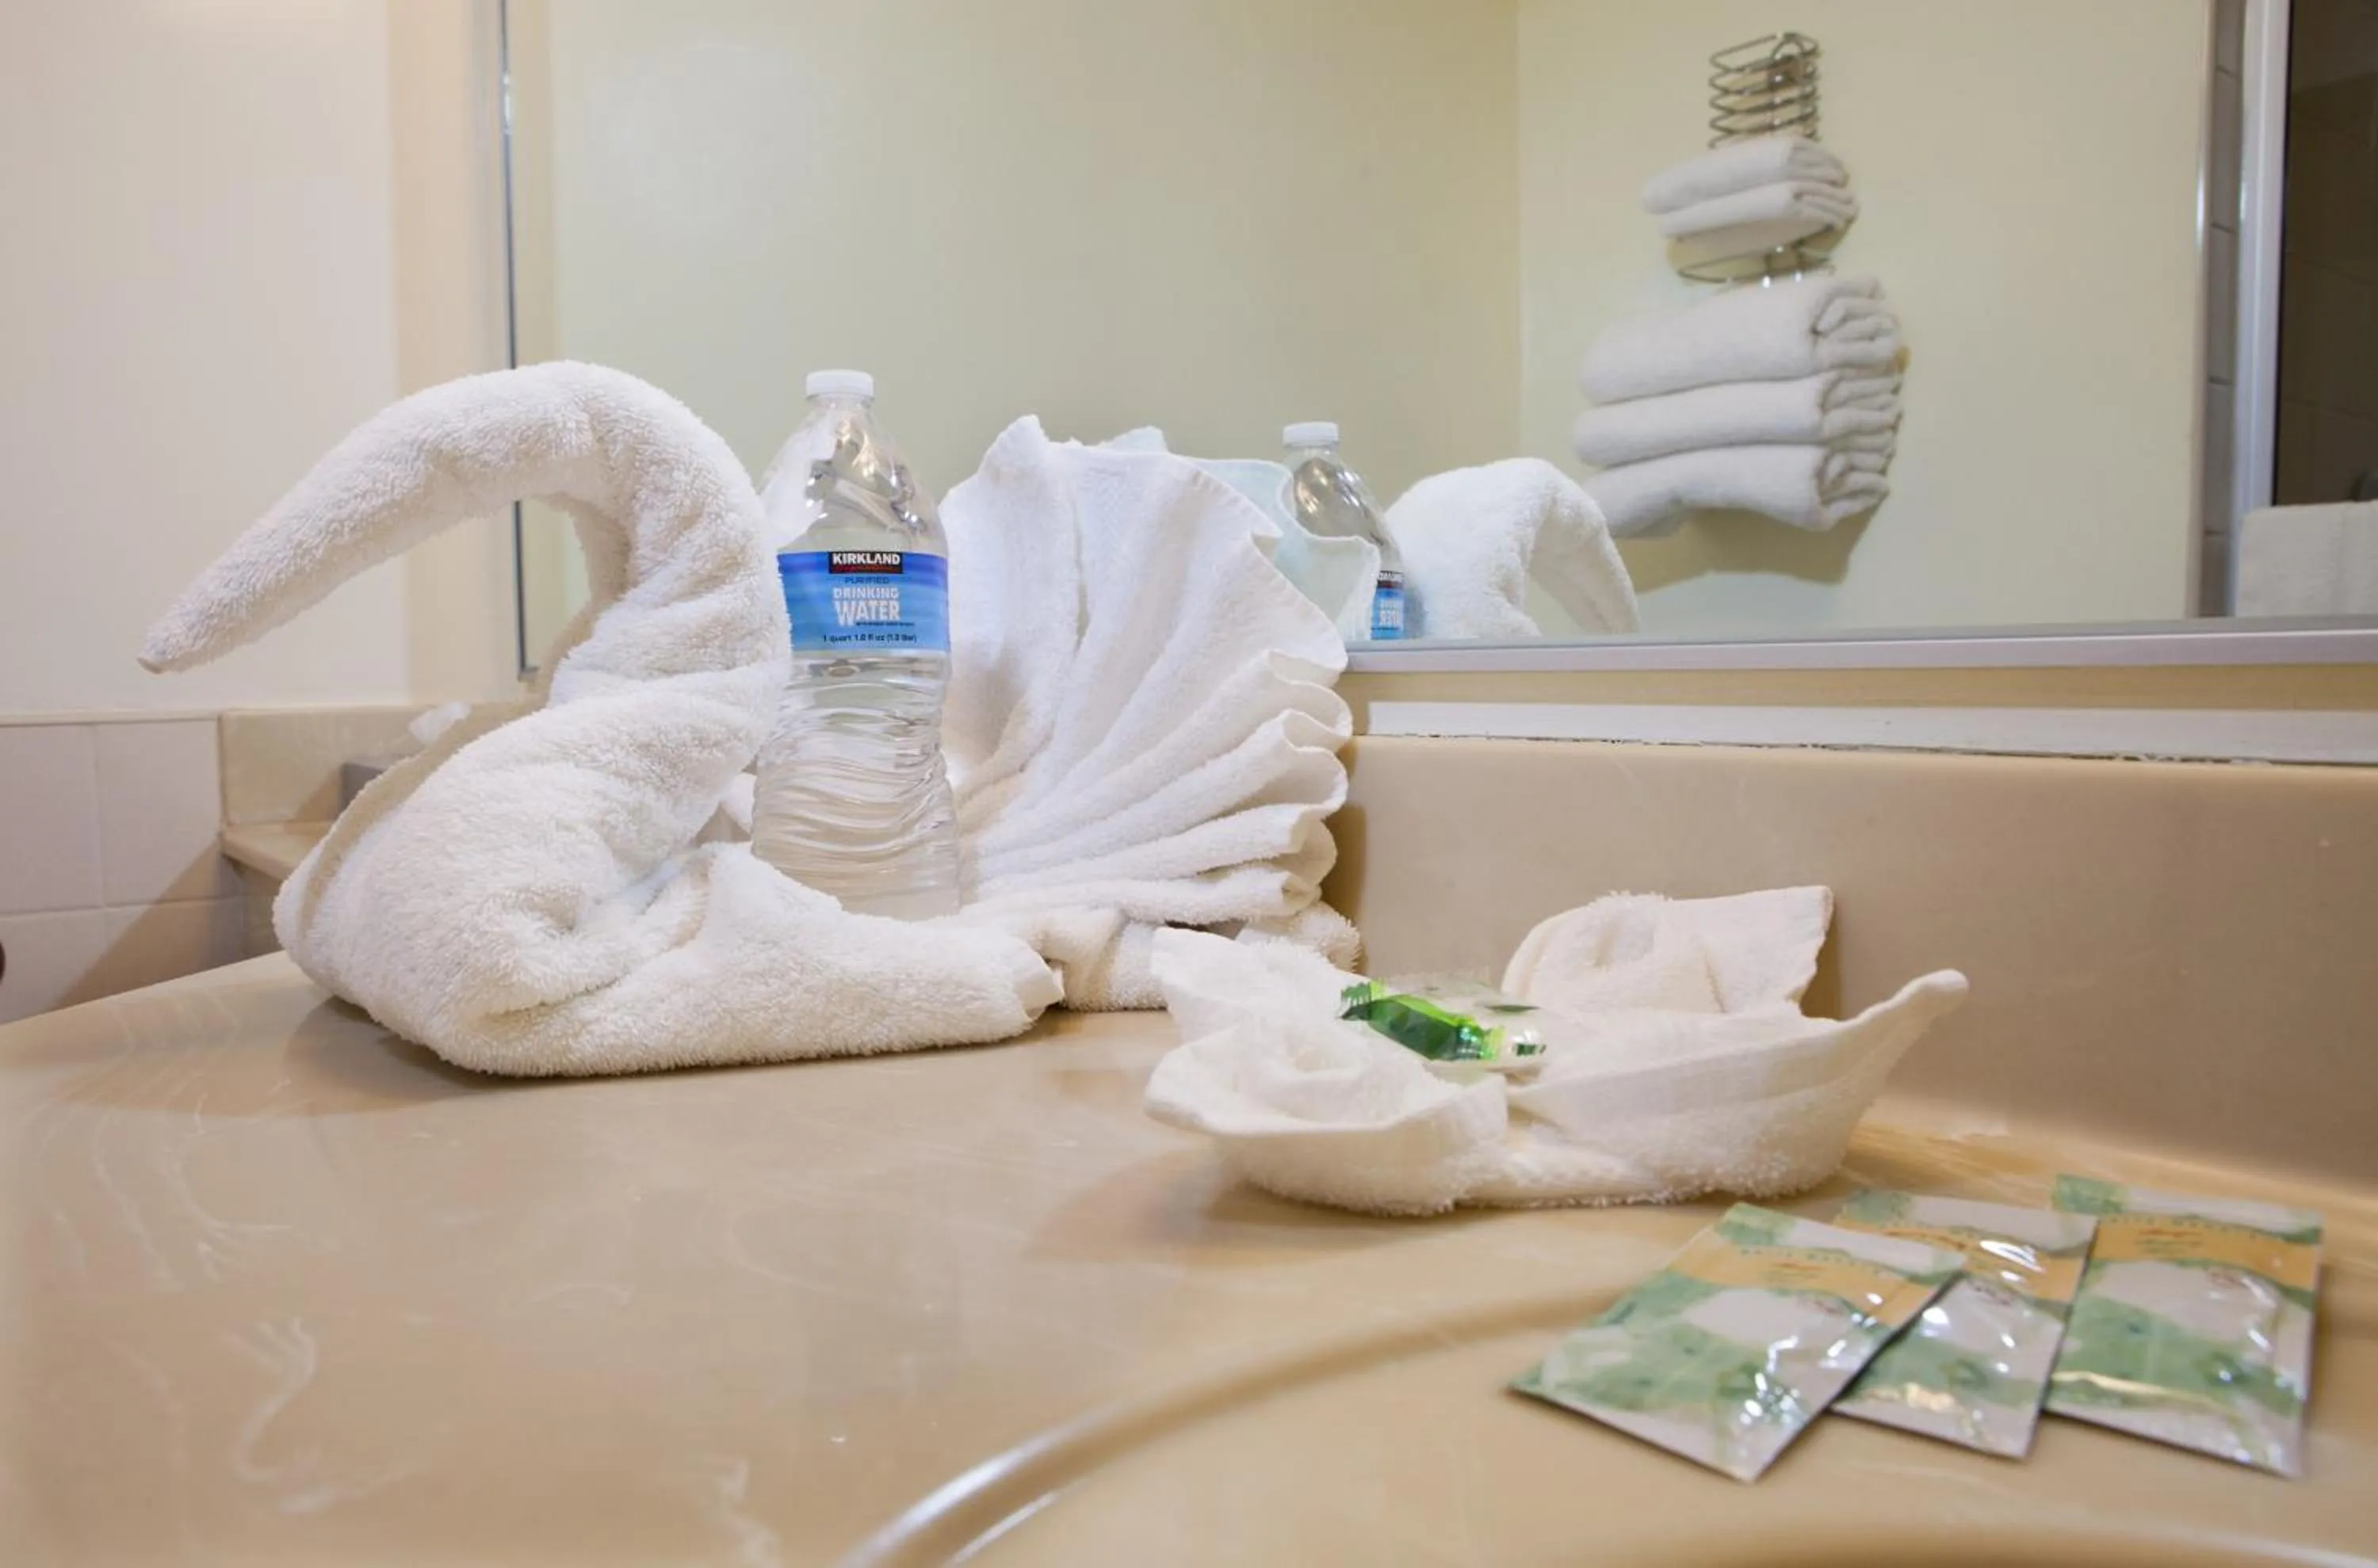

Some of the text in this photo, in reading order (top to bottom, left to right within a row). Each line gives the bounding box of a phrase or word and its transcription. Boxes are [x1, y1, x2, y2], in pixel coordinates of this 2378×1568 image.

[832, 553, 900, 565] KIRKLAND
[834, 587, 899, 599] DRINKING
[834, 600, 900, 626] WATER
